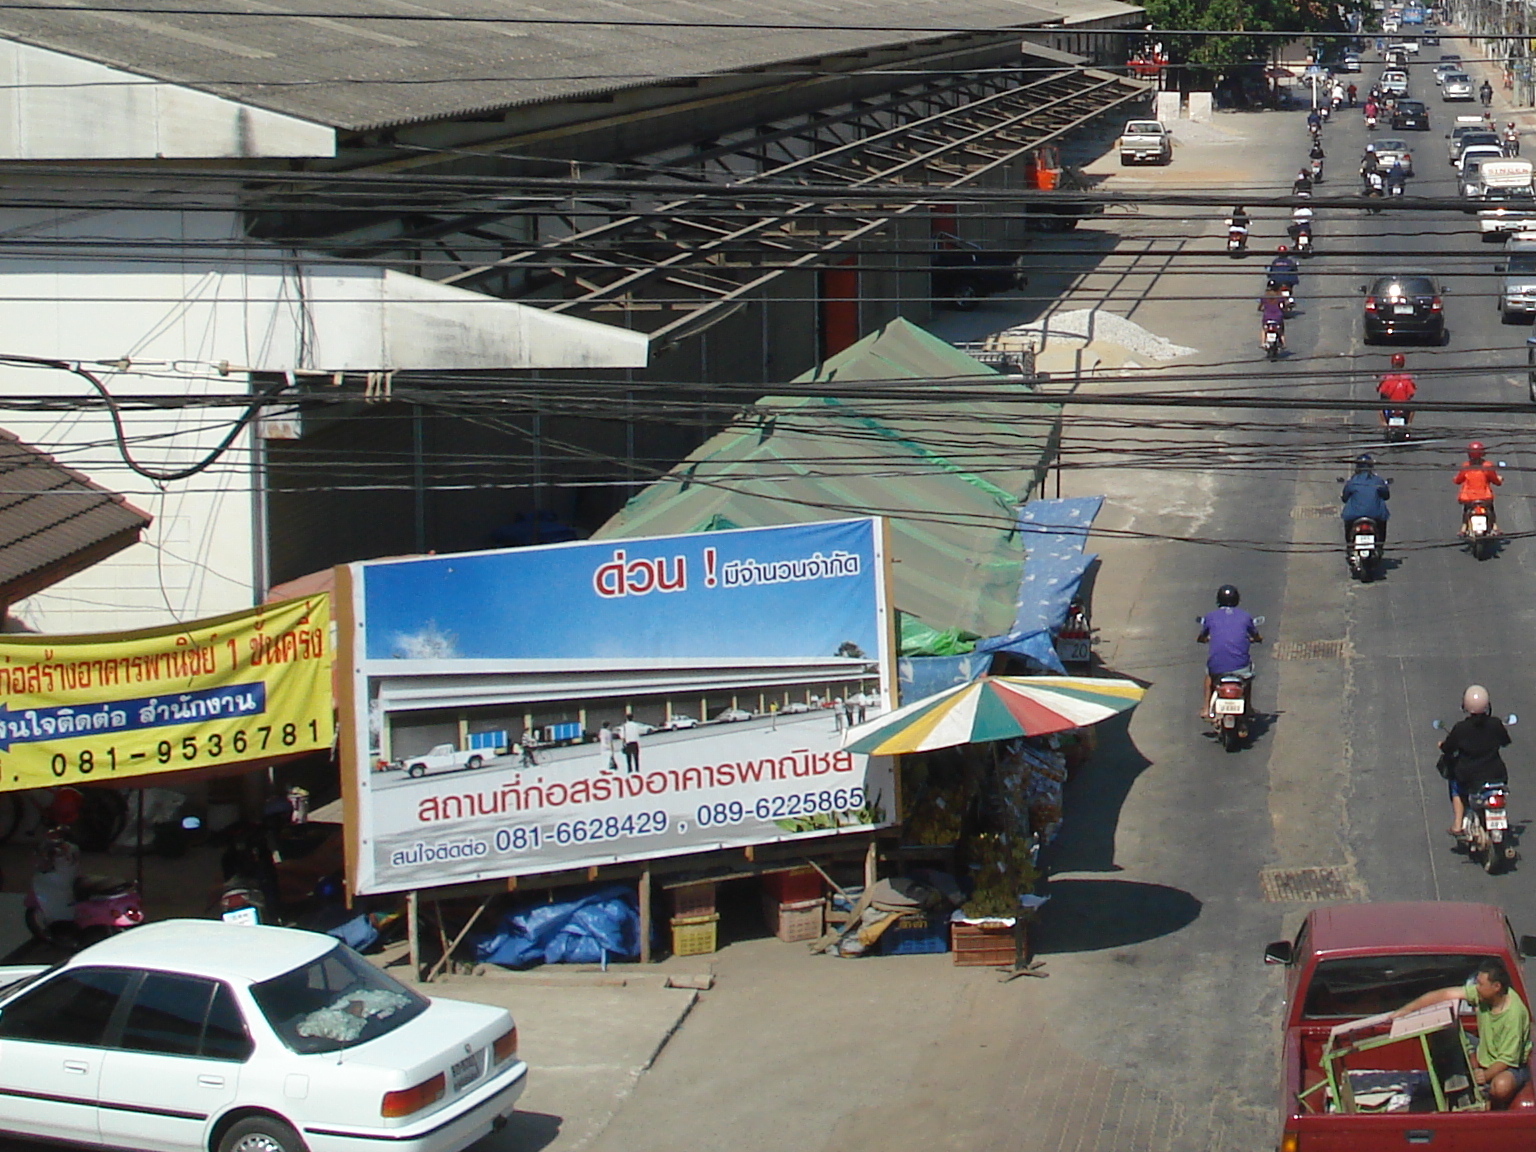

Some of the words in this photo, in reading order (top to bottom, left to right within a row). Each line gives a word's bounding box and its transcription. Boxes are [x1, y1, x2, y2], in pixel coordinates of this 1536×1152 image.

[595, 552, 685, 596] ด่วน
[724, 553, 859, 586] มีจำนวนจำกัด
[226, 639, 237, 671] 1
[139, 694, 257, 723] สำนักงาน
[51, 719, 318, 777] 081-9536781
[418, 749, 853, 822] สถานที่ก่อสร้างอาคารพาณิชย
[392, 839, 487, 866] สนใจติดต่อ
[496, 811, 667, 851] 081-6628429
[697, 787, 864, 826] 089-6225865
